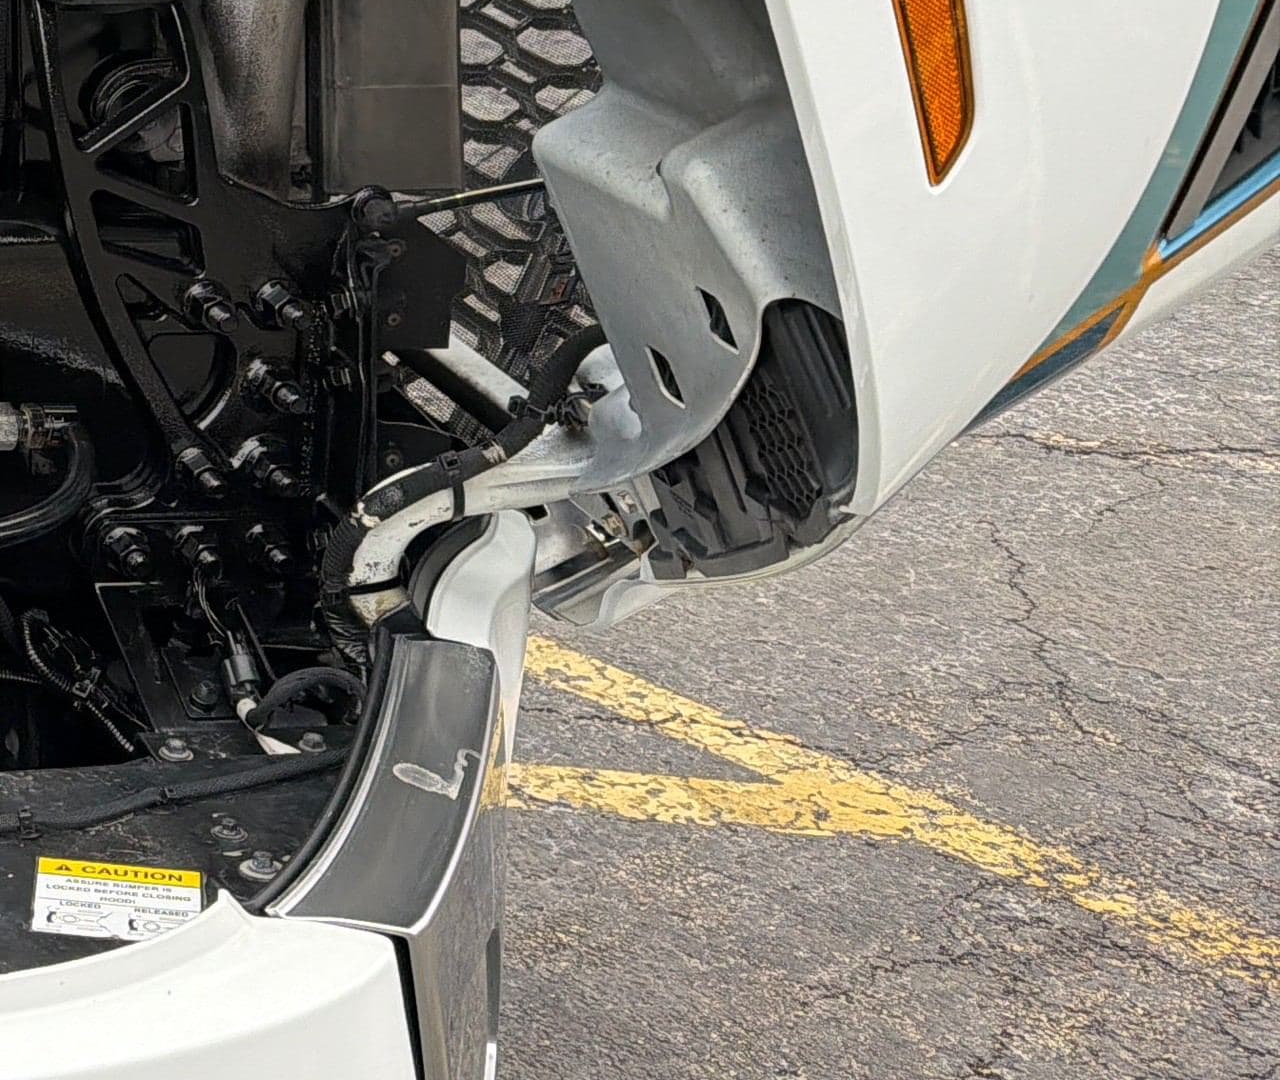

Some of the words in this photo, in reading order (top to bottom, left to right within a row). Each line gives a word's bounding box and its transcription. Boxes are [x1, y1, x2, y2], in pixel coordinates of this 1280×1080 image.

[81, 865, 184, 883] CAUTION
[65, 877, 110, 887] ASSURE
[112, 882, 160, 892] BUMPER
[45, 883, 92, 894] LOCKED
[93, 888, 139, 898] BEFORE
[141, 892, 192, 903] CLOSING
[59, 900, 102, 910] LOCKED
[133, 907, 190, 918] RELEASED
